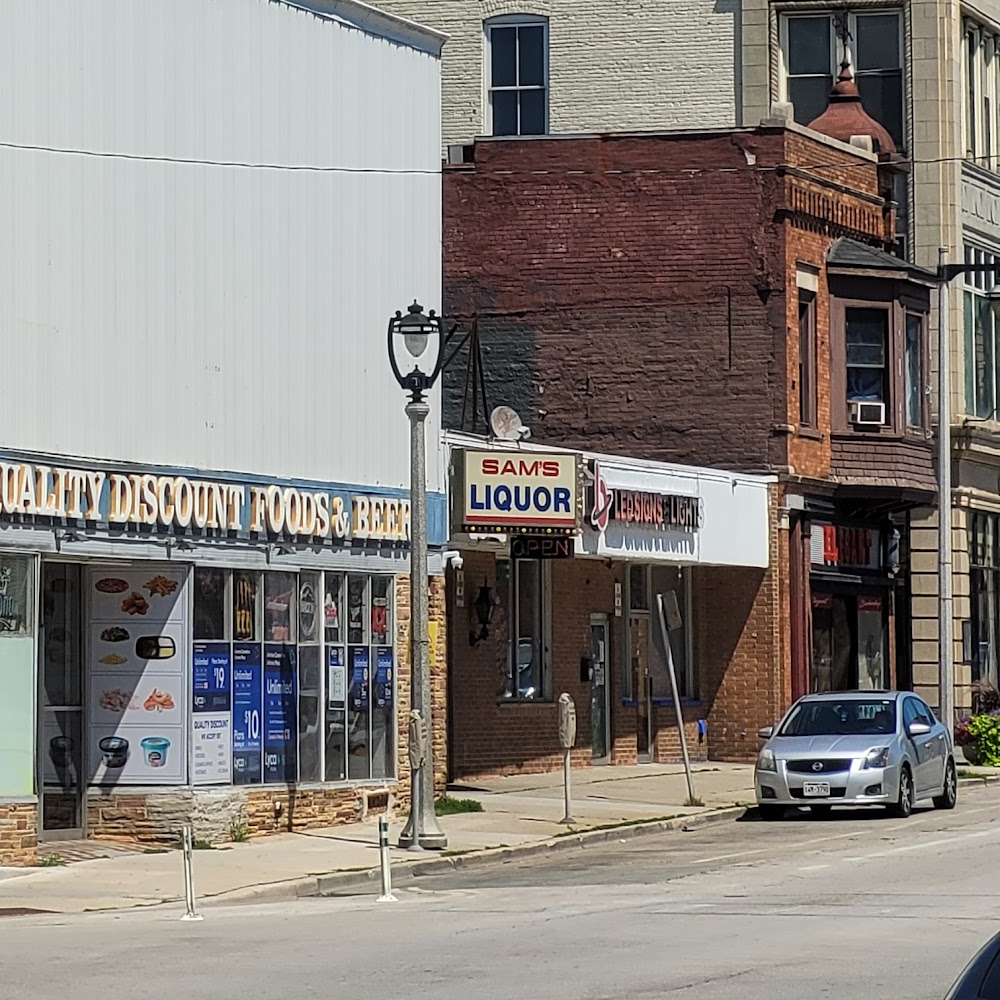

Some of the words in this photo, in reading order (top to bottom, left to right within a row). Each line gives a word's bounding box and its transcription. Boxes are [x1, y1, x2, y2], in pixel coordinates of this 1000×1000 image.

[482, 459, 560, 477] SAM'S
[109, 473, 245, 531] DISCOUNT
[250, 484, 330, 539] FOODS
[331, 496, 350, 539] &
[470, 484, 571, 513] LIQUOR
[512, 539, 570, 556] OPEN
[266, 678, 293, 695] Unlimited
[244, 709, 259, 740] $10
